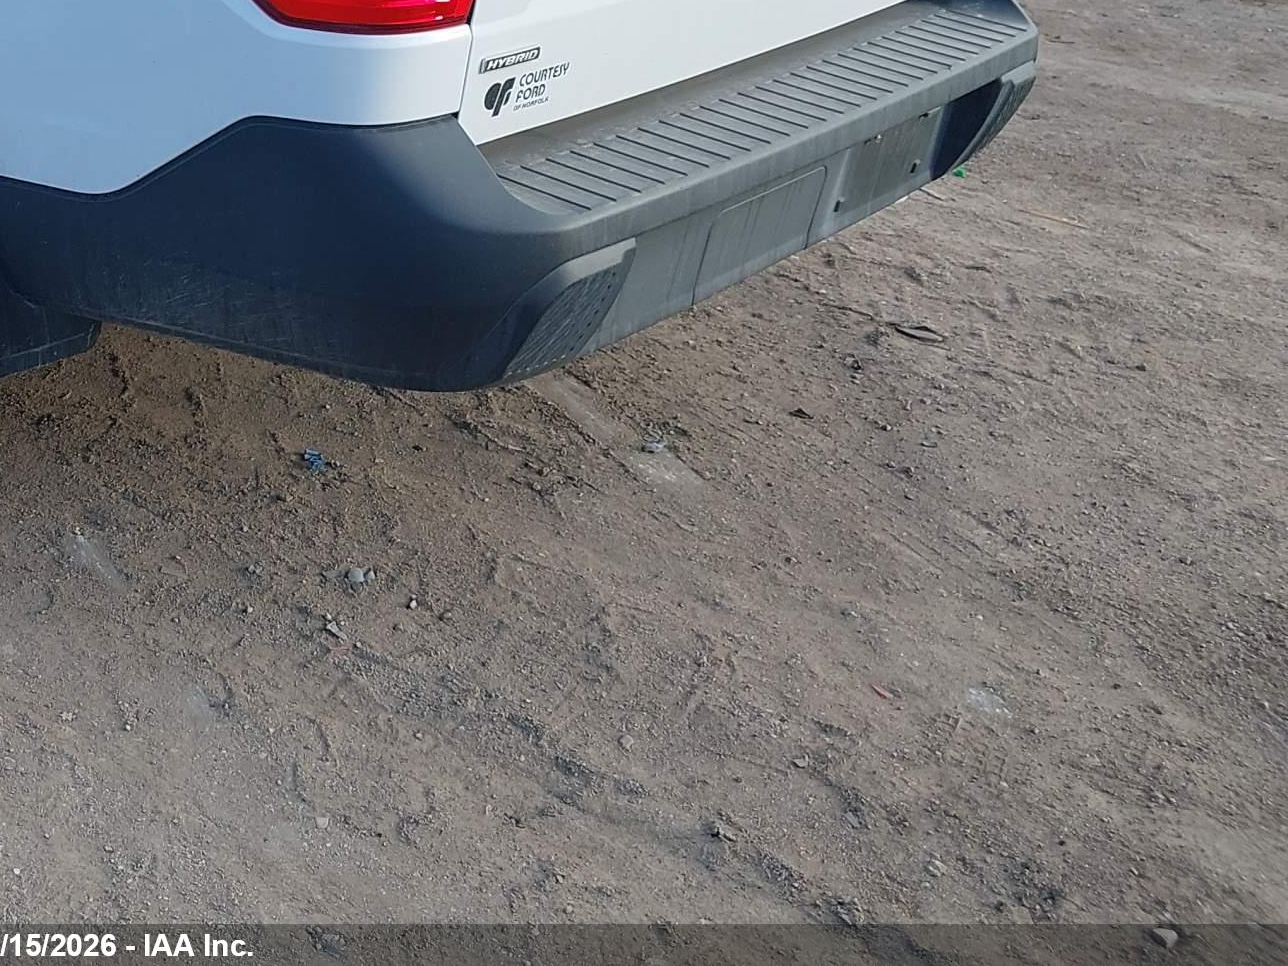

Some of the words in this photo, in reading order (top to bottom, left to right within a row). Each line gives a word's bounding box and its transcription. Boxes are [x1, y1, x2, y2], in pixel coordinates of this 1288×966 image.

[486, 48, 539, 71] HYBRID
[519, 61, 570, 87] COURTESY
[515, 83, 546, 103] FORD
[522, 96, 550, 110] NORFOLK
